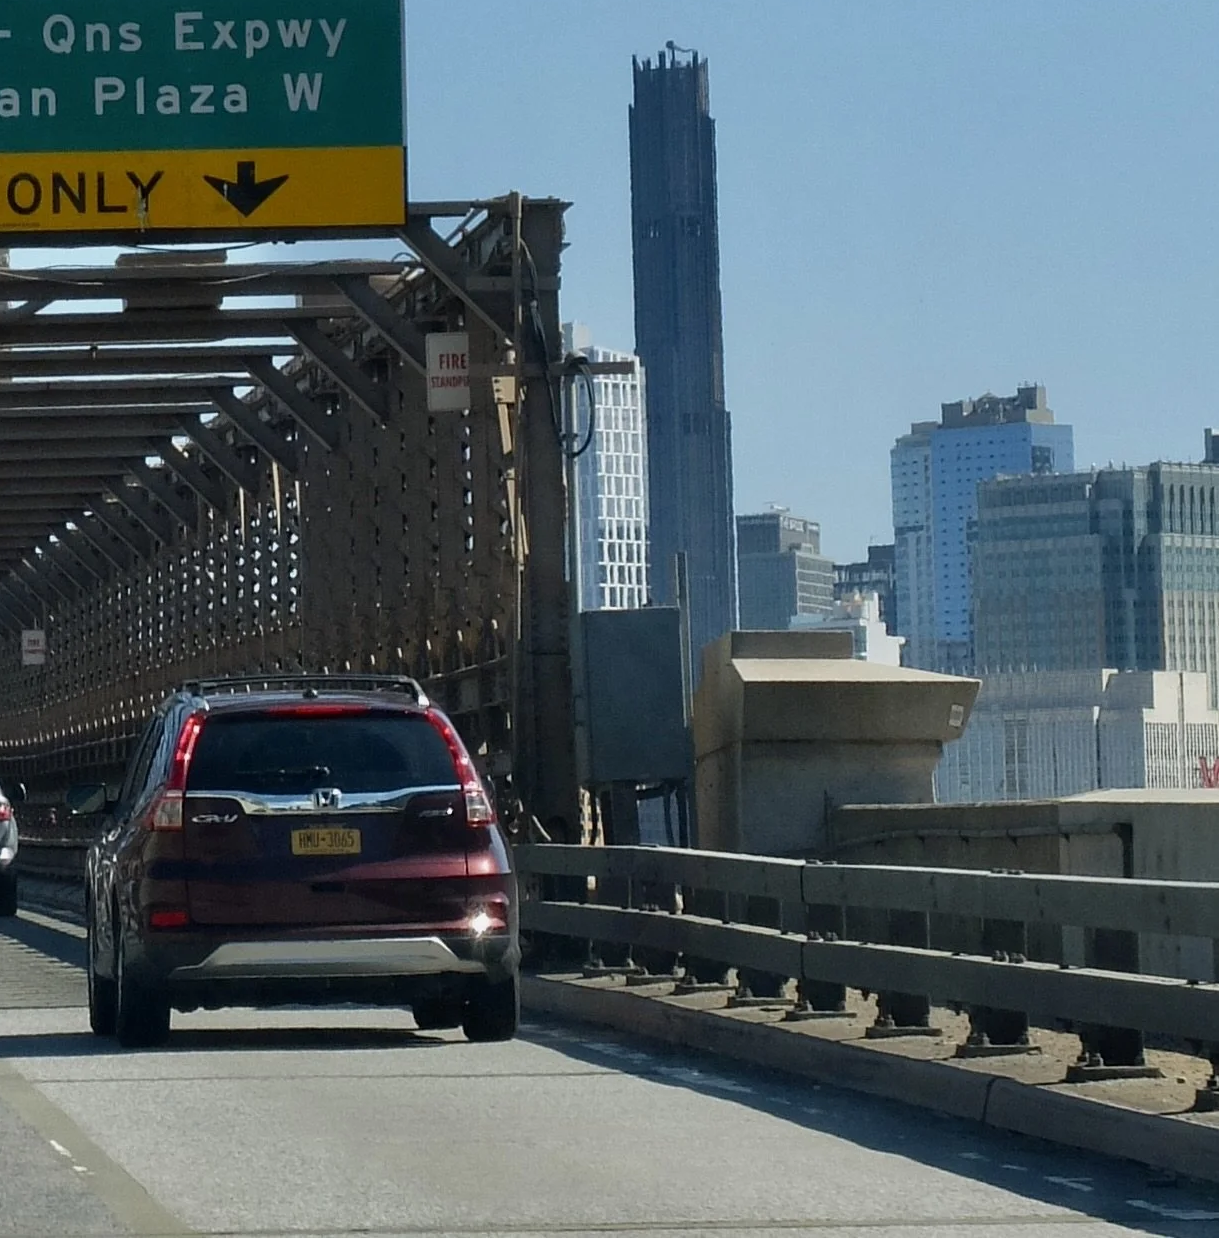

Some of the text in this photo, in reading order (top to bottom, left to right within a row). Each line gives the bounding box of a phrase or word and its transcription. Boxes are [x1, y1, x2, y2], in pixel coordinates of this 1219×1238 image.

[42, 14, 143, 54] Qns
[174, 12, 347, 59] Expwy
[94, 76, 248, 115] Plaza
[283, 72, 323, 112] W
[6, 170, 164, 215] ONLY
[438, 353, 467, 370] FIRE
